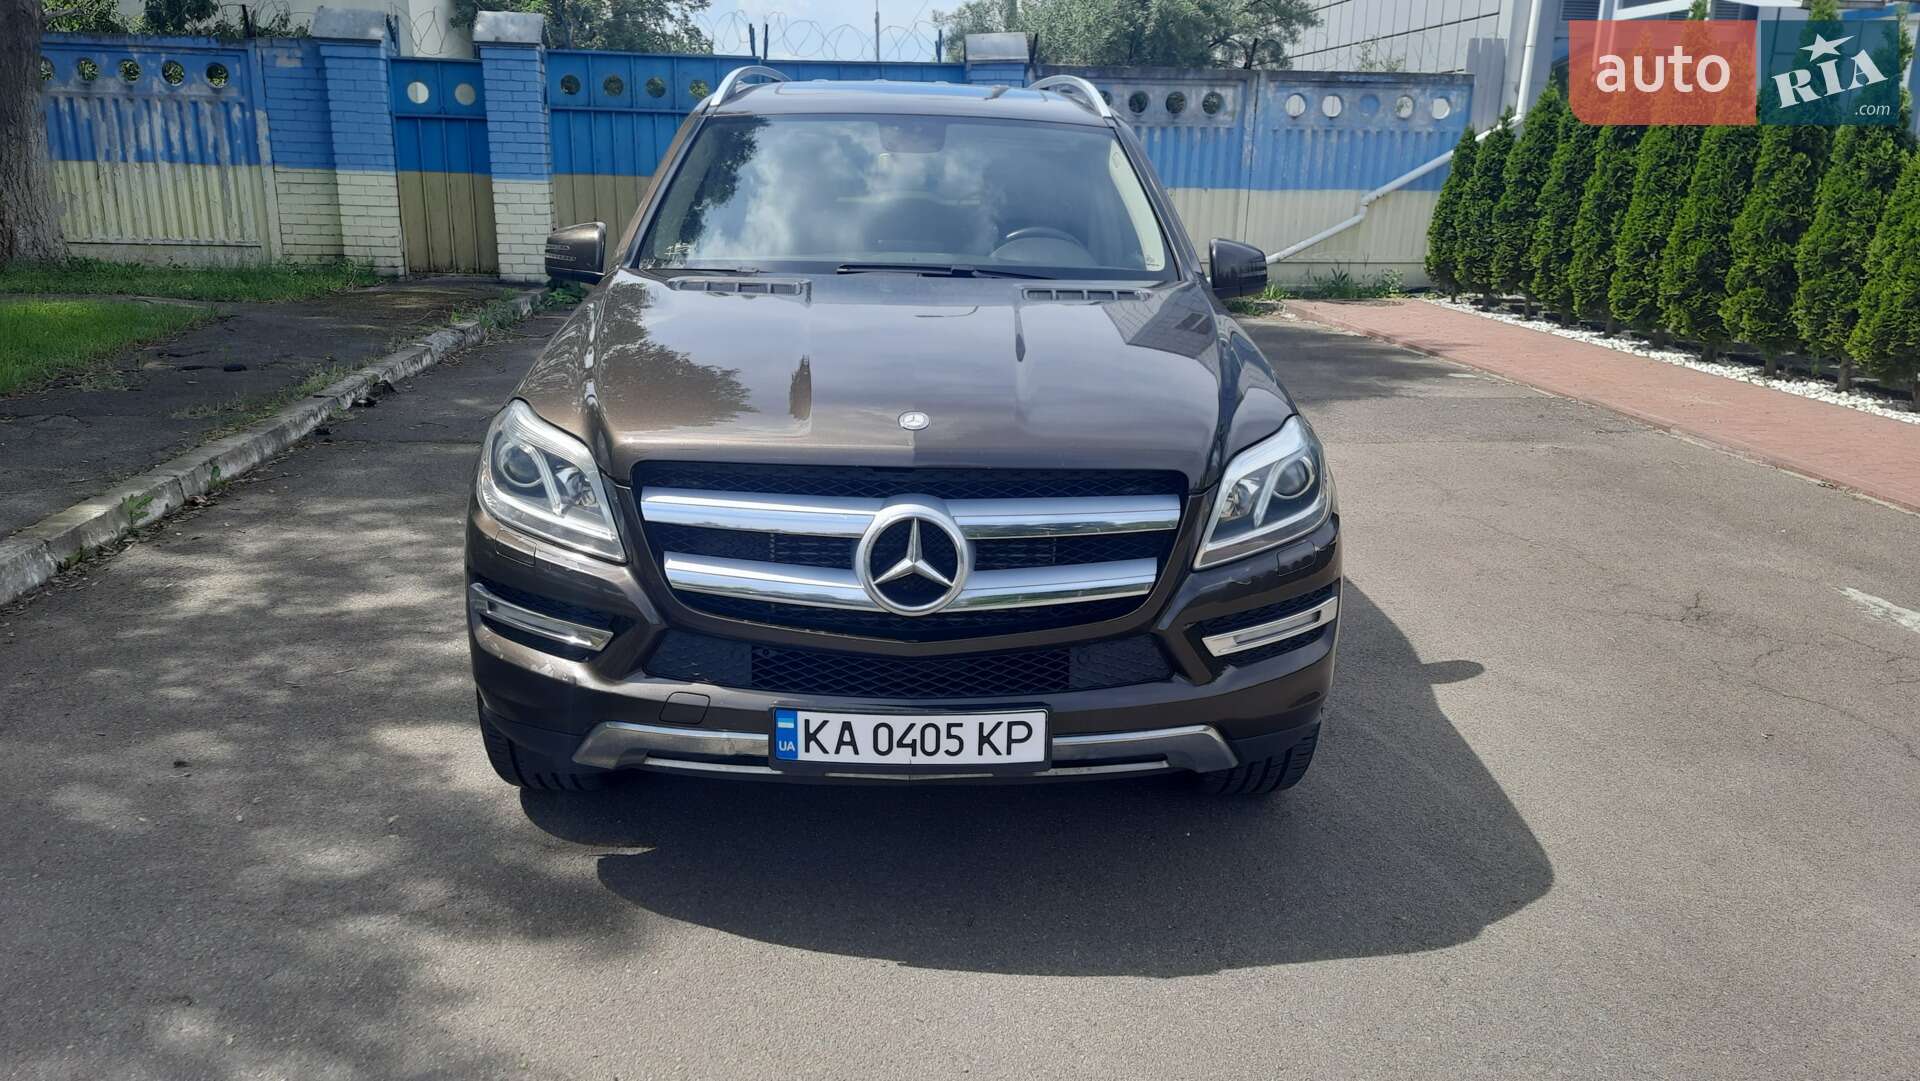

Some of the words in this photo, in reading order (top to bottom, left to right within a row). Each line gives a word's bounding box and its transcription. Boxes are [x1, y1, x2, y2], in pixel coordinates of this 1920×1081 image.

[778, 740, 795, 752] UA
[803, 718, 859, 755] KA
[872, 722, 963, 757] 0405
[977, 720, 1033, 756] KP
